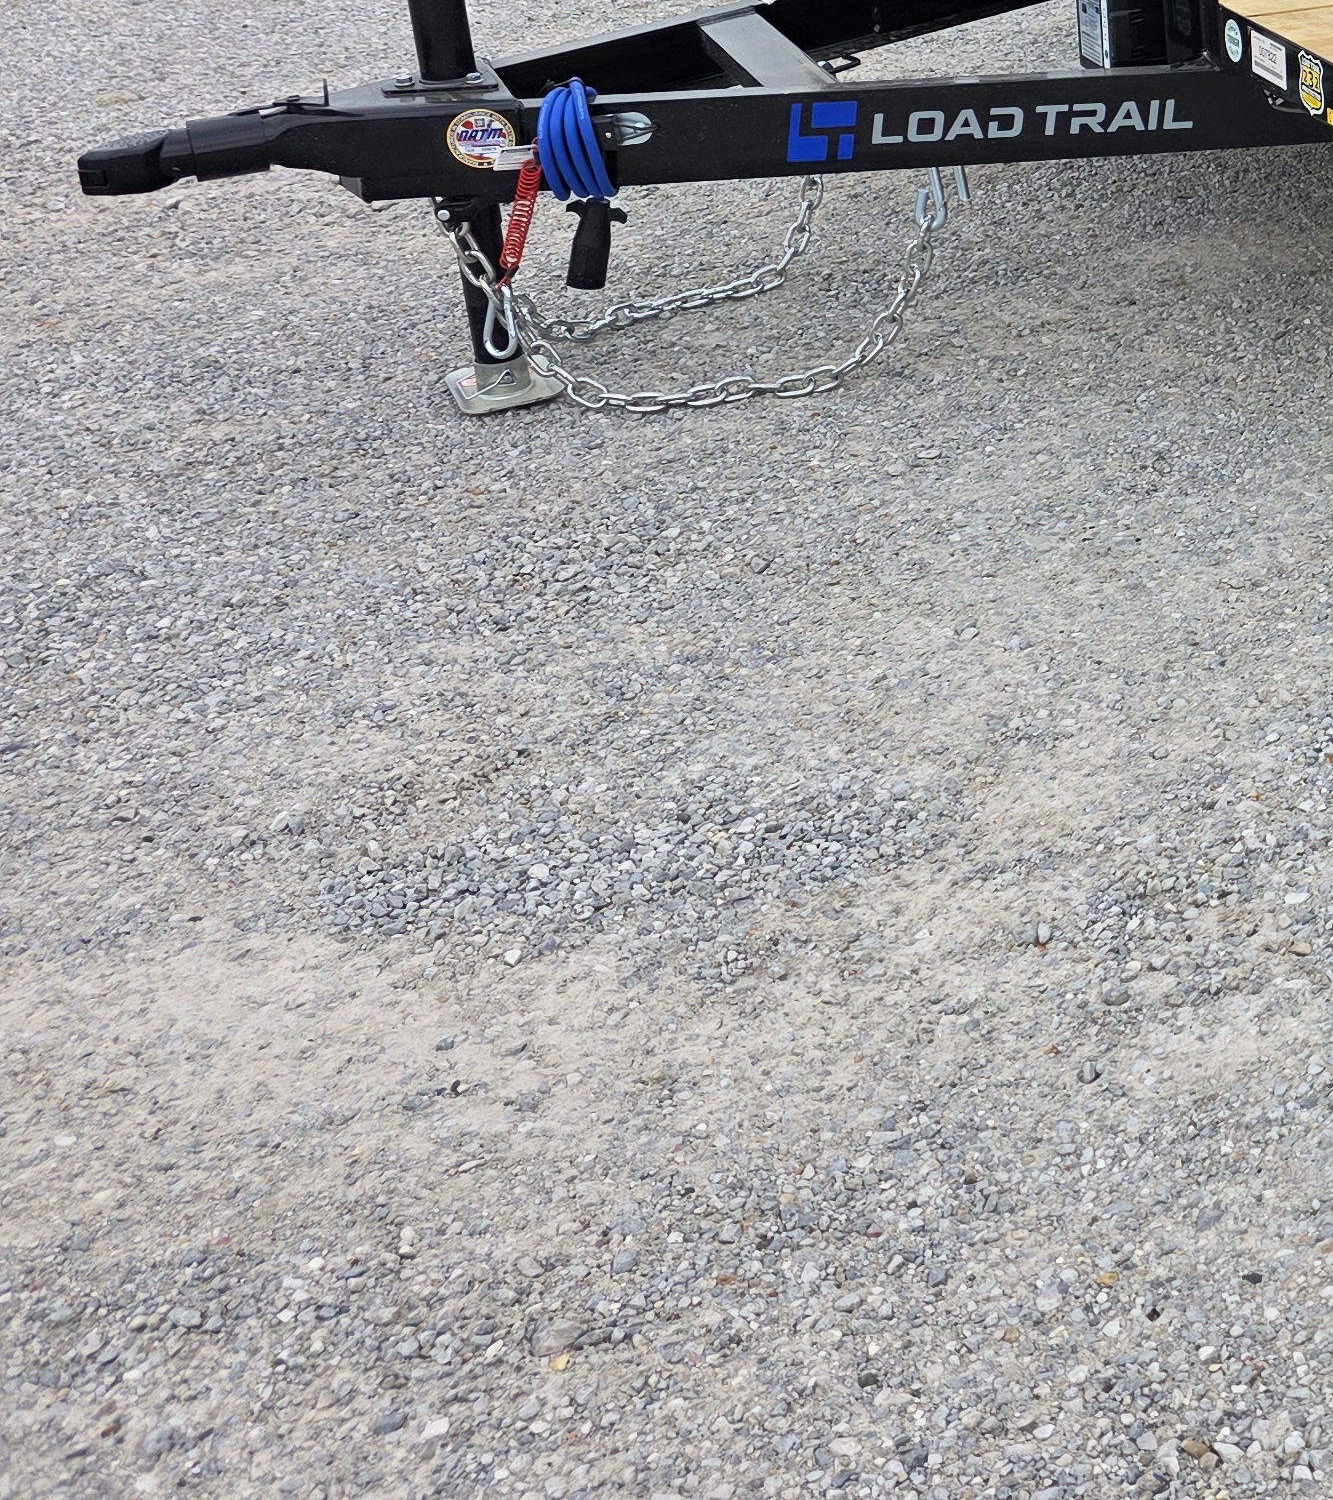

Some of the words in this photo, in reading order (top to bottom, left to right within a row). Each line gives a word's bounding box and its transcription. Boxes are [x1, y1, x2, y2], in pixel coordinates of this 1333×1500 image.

[1302, 69, 1320, 90] 232
[871, 107, 1025, 145] LOAD
[1035, 99, 1194, 136] TRAIL
[457, 128, 504, 142] NATM
